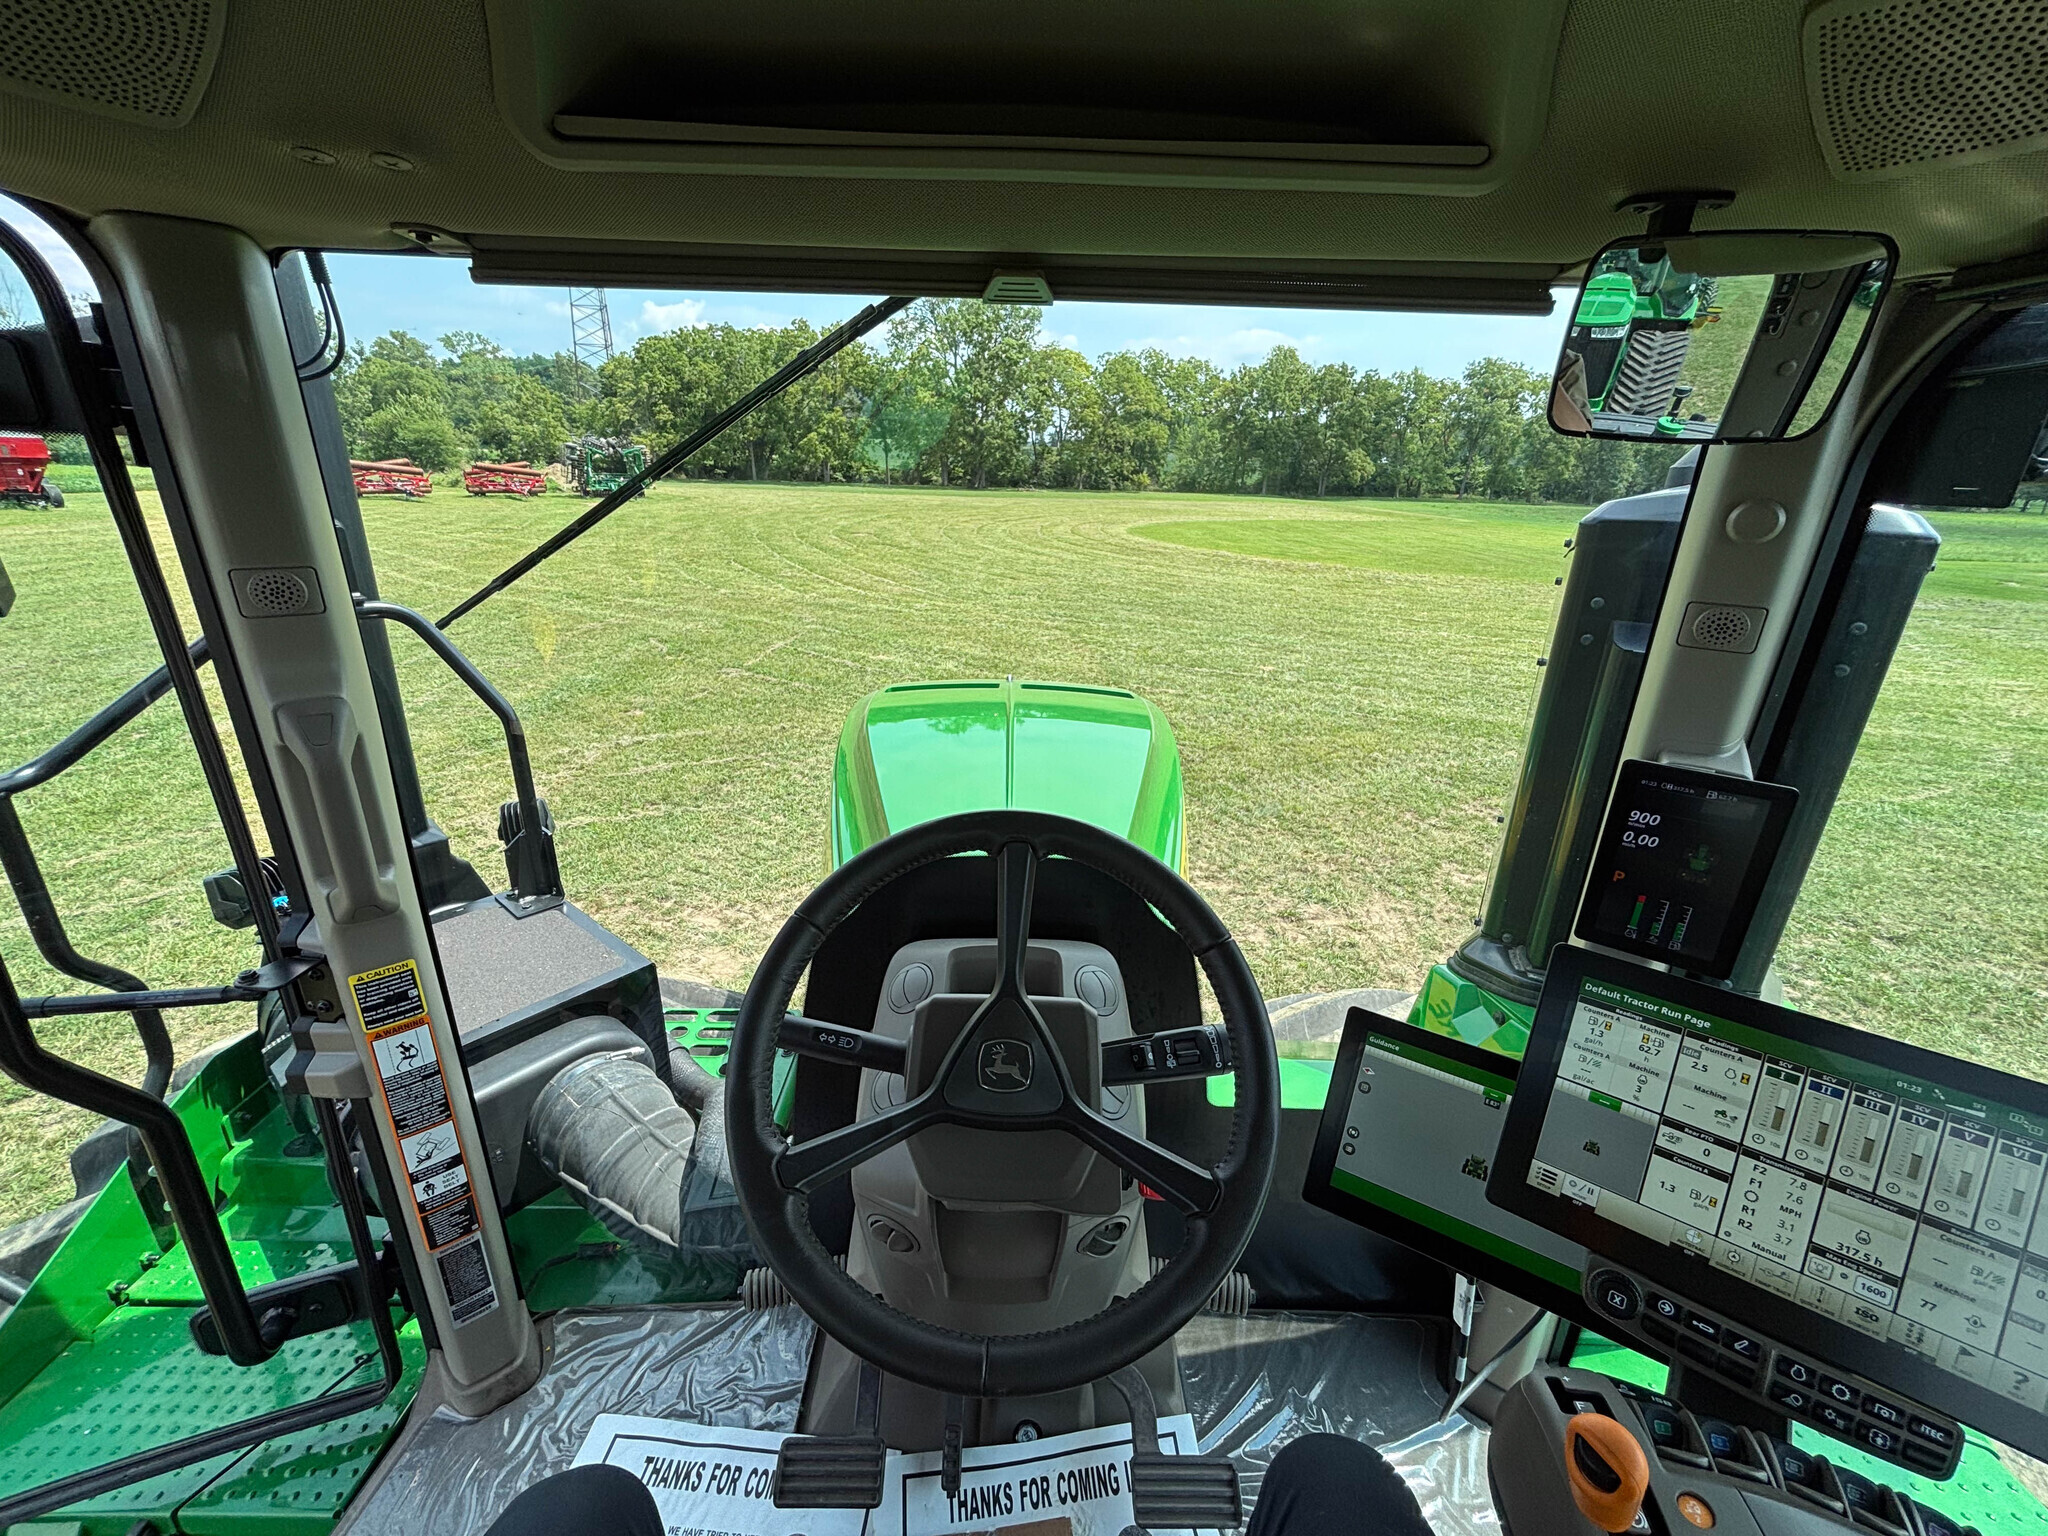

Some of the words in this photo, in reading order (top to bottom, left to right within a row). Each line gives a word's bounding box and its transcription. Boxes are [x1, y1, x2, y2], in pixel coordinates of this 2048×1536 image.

[1628, 810, 1661, 826] 900
[1622, 831, 1659, 848] 0.00
[1612, 870, 1626, 882] P
[365, 962, 409, 979] CAUTION
[1583, 1005, 1614, 1020] Counters
[1585, 983, 1621, 1000] Default
[1623, 995, 1659, 1012] Tractor
[1661, 1008, 1682, 1020] Run
[1684, 1014, 1712, 1029] Page
[1615, 1008, 1643, 1021] Readings
[382, 1017, 425, 1035] WARNING
[1589, 1028, 1604, 1038] 1.3
[1639, 1024, 1671, 1038] Machine
[1369, 1036, 1400, 1052] Guidance
[1583, 1036, 1603, 1047] gal/h
[1708, 1038, 1739, 1052] Readings
[1573, 1042, 1604, 1058] Counters
[1638, 1044, 1661, 1057] 62.7
[1682, 1048, 1700, 1058] Idle
[1700, 1044, 1735, 1060] Counters
[1629, 1062, 1660, 1078] Machine
[1690, 1061, 1708, 1073] 2.5
[1778, 1061, 1793, 1069] SCV
[1572, 1073, 1595, 1086] gal/ac
[1778, 1072, 1784, 1080] I
[1822, 1075, 1838, 1083] SCV
[1635, 1085, 1642, 1093] 3
[1694, 1085, 1728, 1101] Machine
[1820, 1086, 1832, 1095] II
[1868, 1090, 1883, 1098] SCV
[1896, 1080, 1922, 1094] 01:23
[1863, 1099, 1881, 1112] III
[1914, 1104, 1931, 1114] SCV
[1910, 1115, 1929, 1126] IV
[1964, 1120, 1981, 1130] SCV
[1684, 1127, 1700, 1138] Rear
[1699, 1132, 1714, 1142] PTO
[1963, 1132, 1976, 1142] V
[2015, 1137, 2033, 1146] SCV
[1702, 1148, 1711, 1157] 0
[2012, 1147, 2031, 1160] VI
[1672, 1156, 1702, 1172] Counters
[1759, 1156, 1805, 1177] Transmission
[442, 1175, 459, 1184] SEAT
[443, 1180, 460, 1189] BELT
[1752, 1164, 1768, 1176] F2
[1789, 1177, 1807, 1191] 7.8
[1659, 1181, 1676, 1193] 1.3
[1749, 1177, 1763, 1189] F1
[1785, 1191, 1804, 1205] 7.6
[1846, 1188, 1873, 1202] Engine
[1872, 1197, 1899, 1212] Power
[1741, 1204, 1756, 1217] R1
[1777, 1219, 1795, 1233] 3.1
[1779, 1204, 1802, 1219] MPH
[1737, 1218, 1753, 1230] R2
[1773, 1233, 1793, 1247] 3.7
[439, 1236, 475, 1254] IMPORTANT
[1751, 1241, 1787, 1262] Manual
[1939, 1234, 1986, 1257] Counters
[1988, 1252, 1996, 1260] A
[1835, 1241, 1872, 1263] 317.5
[1873, 1257, 1883, 1268] h
[1825, 1251, 1841, 1263] Max
[1857, 1264, 1883, 1280] Speed
[1860, 1282, 1887, 1299] 1600
[1933, 1281, 1977, 1303] Machine
[1920, 1298, 1937, 1312] 77
[1853, 1306, 1880, 1323] ISO
[640, 1455, 707, 1492] THANKS
[705, 1462, 740, 1497] FOR
[949, 1482, 1014, 1524] THANKS
[1019, 1475, 1052, 1512] FOR
[1056, 1464, 1120, 1505] COMING
[667, 1525, 681, 1535] WE
[681, 1527, 705, 1536] HAVE
